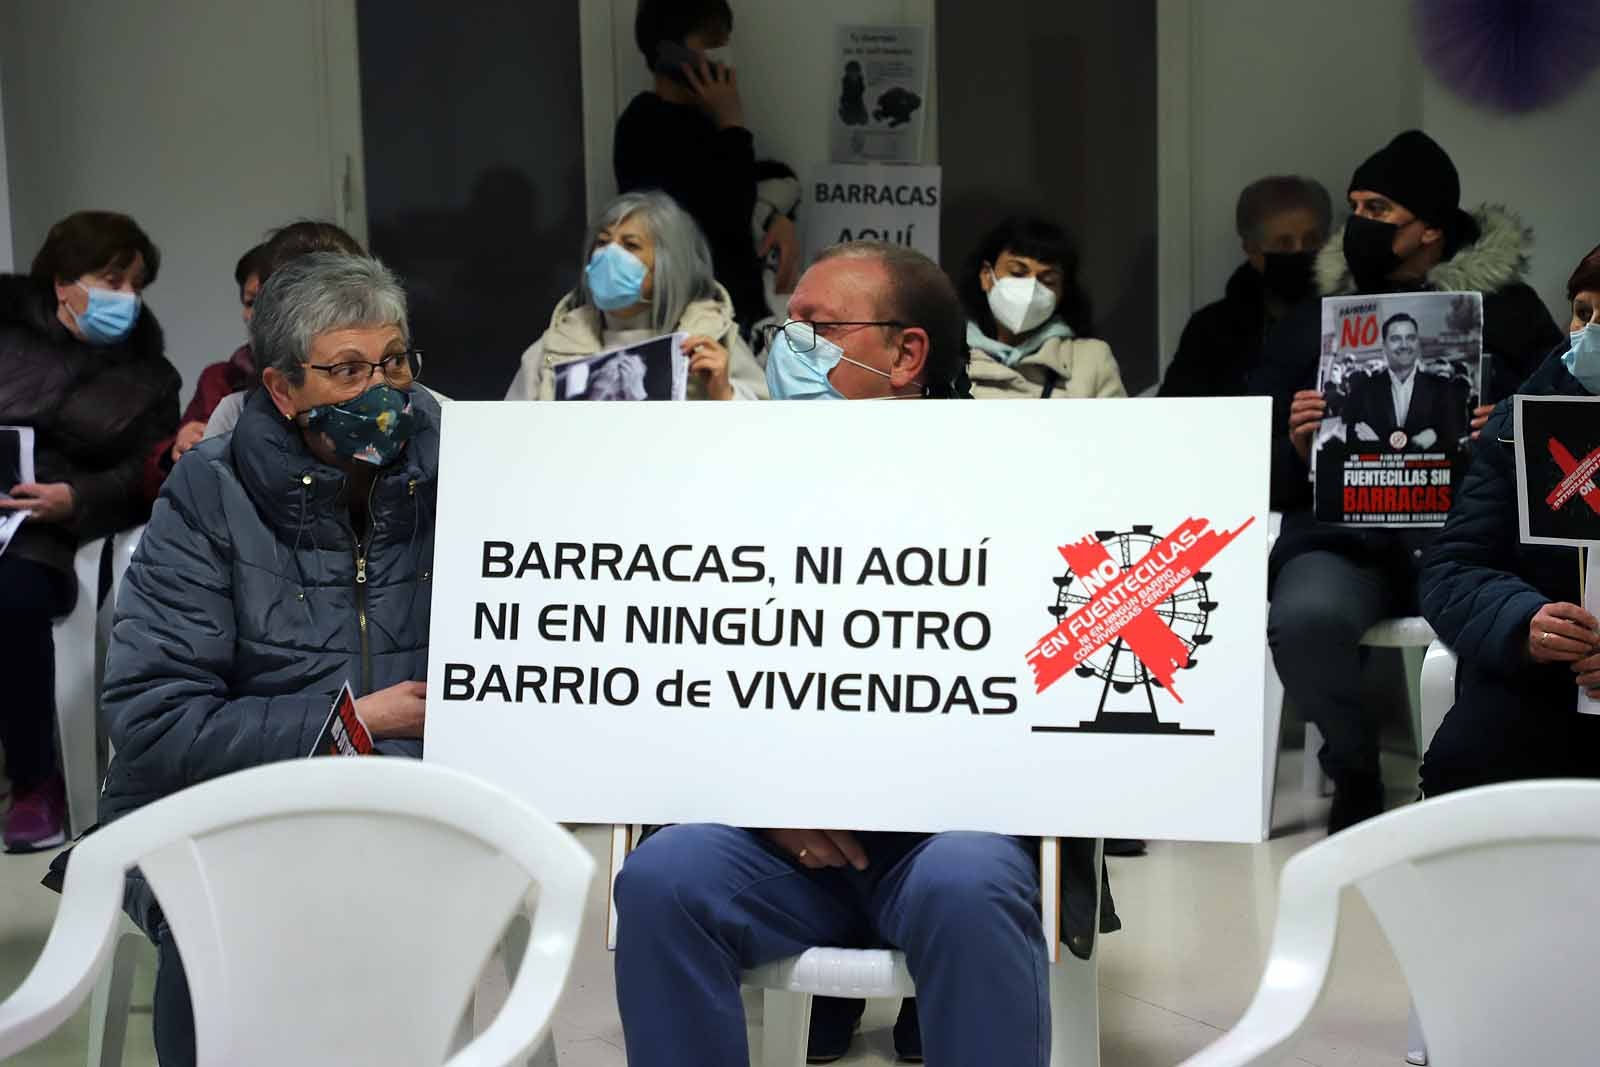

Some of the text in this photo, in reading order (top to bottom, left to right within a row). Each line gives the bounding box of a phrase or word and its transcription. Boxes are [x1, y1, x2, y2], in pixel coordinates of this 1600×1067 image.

[815, 182, 937, 207] BARRACAS
[1340, 312, 1379, 348] NO
[1343, 469, 1451, 486] FUENTECILLAS SIN
[1579, 478, 1597, 497] NO
[1343, 485, 1453, 513] BARRACAS
[481, 537, 990, 586] BARRACAS, NI AQUÍ
[1081, 559, 1120, 595] NO
[1040, 529, 1198, 659] EN FUENTECILLAS
[1073, 566, 1192, 661] CON VIVIENDAS CERCANAS
[1078, 634, 1093, 647] NI
[1090, 623, 1105, 637] EN
[1138, 568, 1175, 599] BARRIO
[474, 598, 991, 651] NI EN NINGÚN OTRO
[442, 663, 1018, 715] BARRIO de VIVIENDAS
